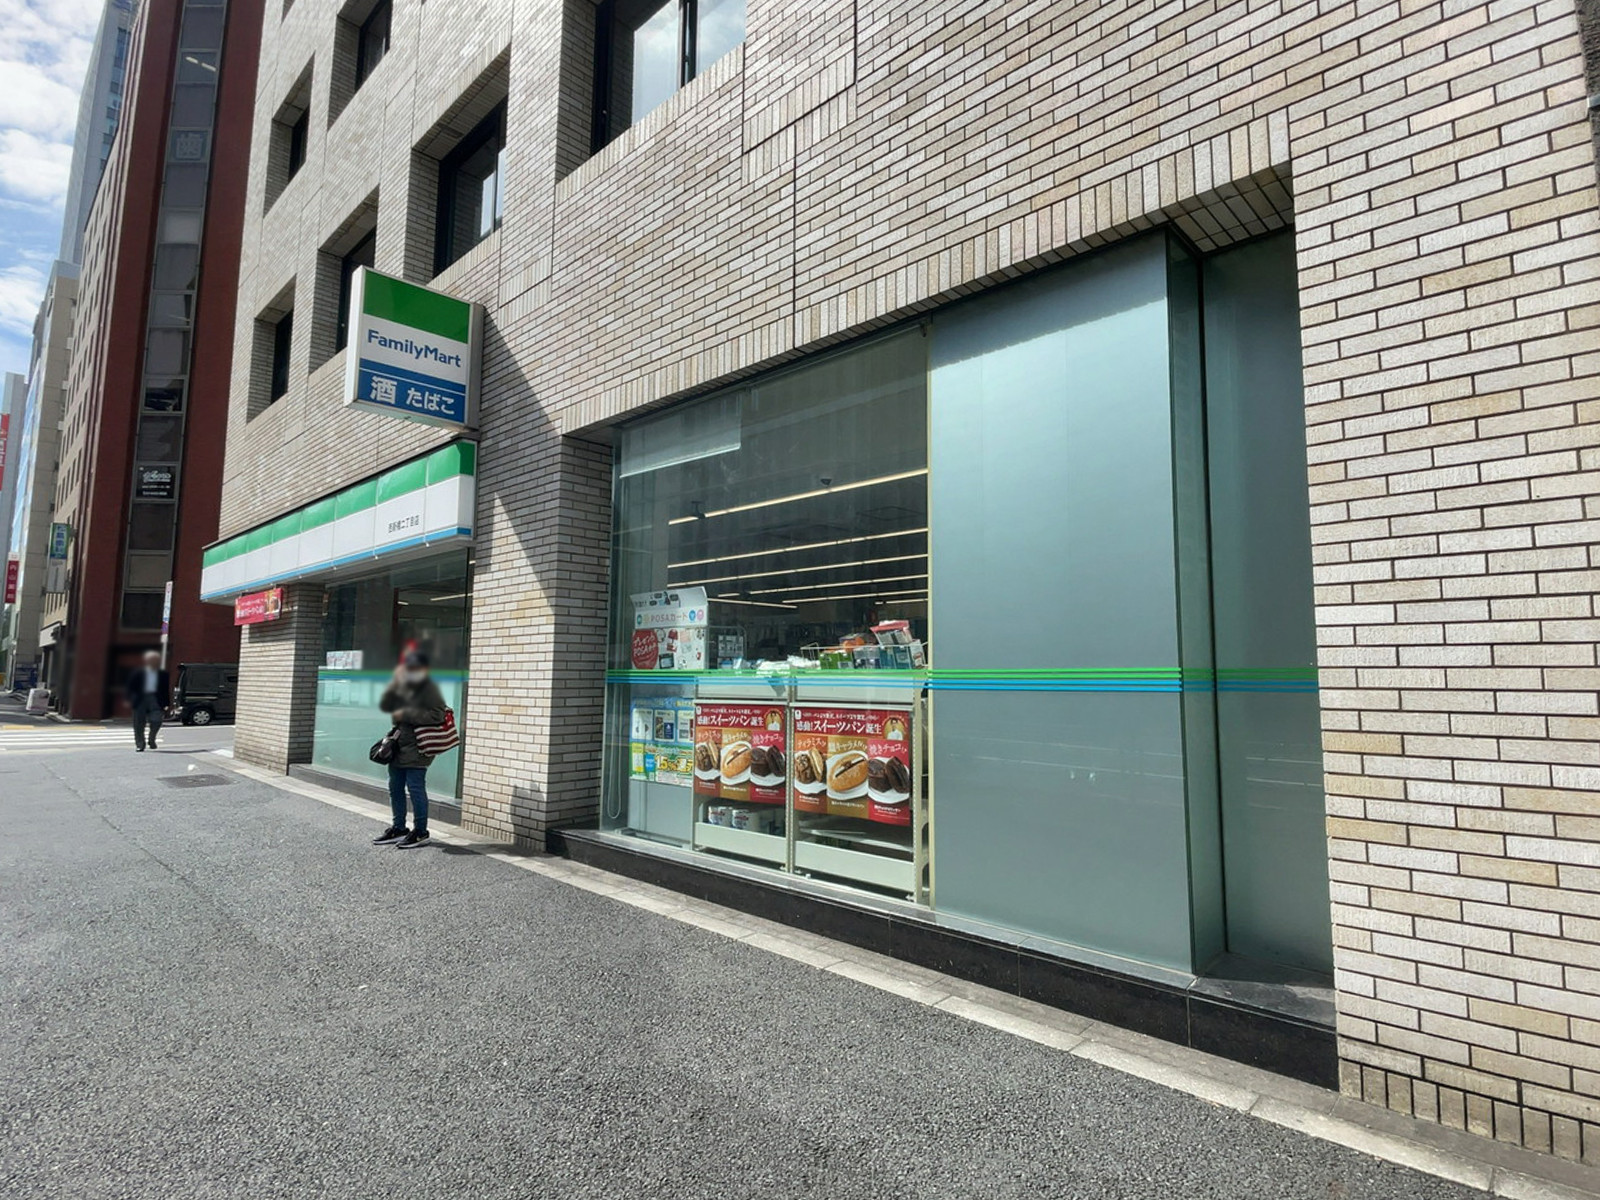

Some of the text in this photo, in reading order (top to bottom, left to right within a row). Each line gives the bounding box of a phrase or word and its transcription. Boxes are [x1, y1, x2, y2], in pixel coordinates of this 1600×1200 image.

[367, 329, 462, 368] FamilyMart
[369, 375, 455, 415] 酒 たばこ
